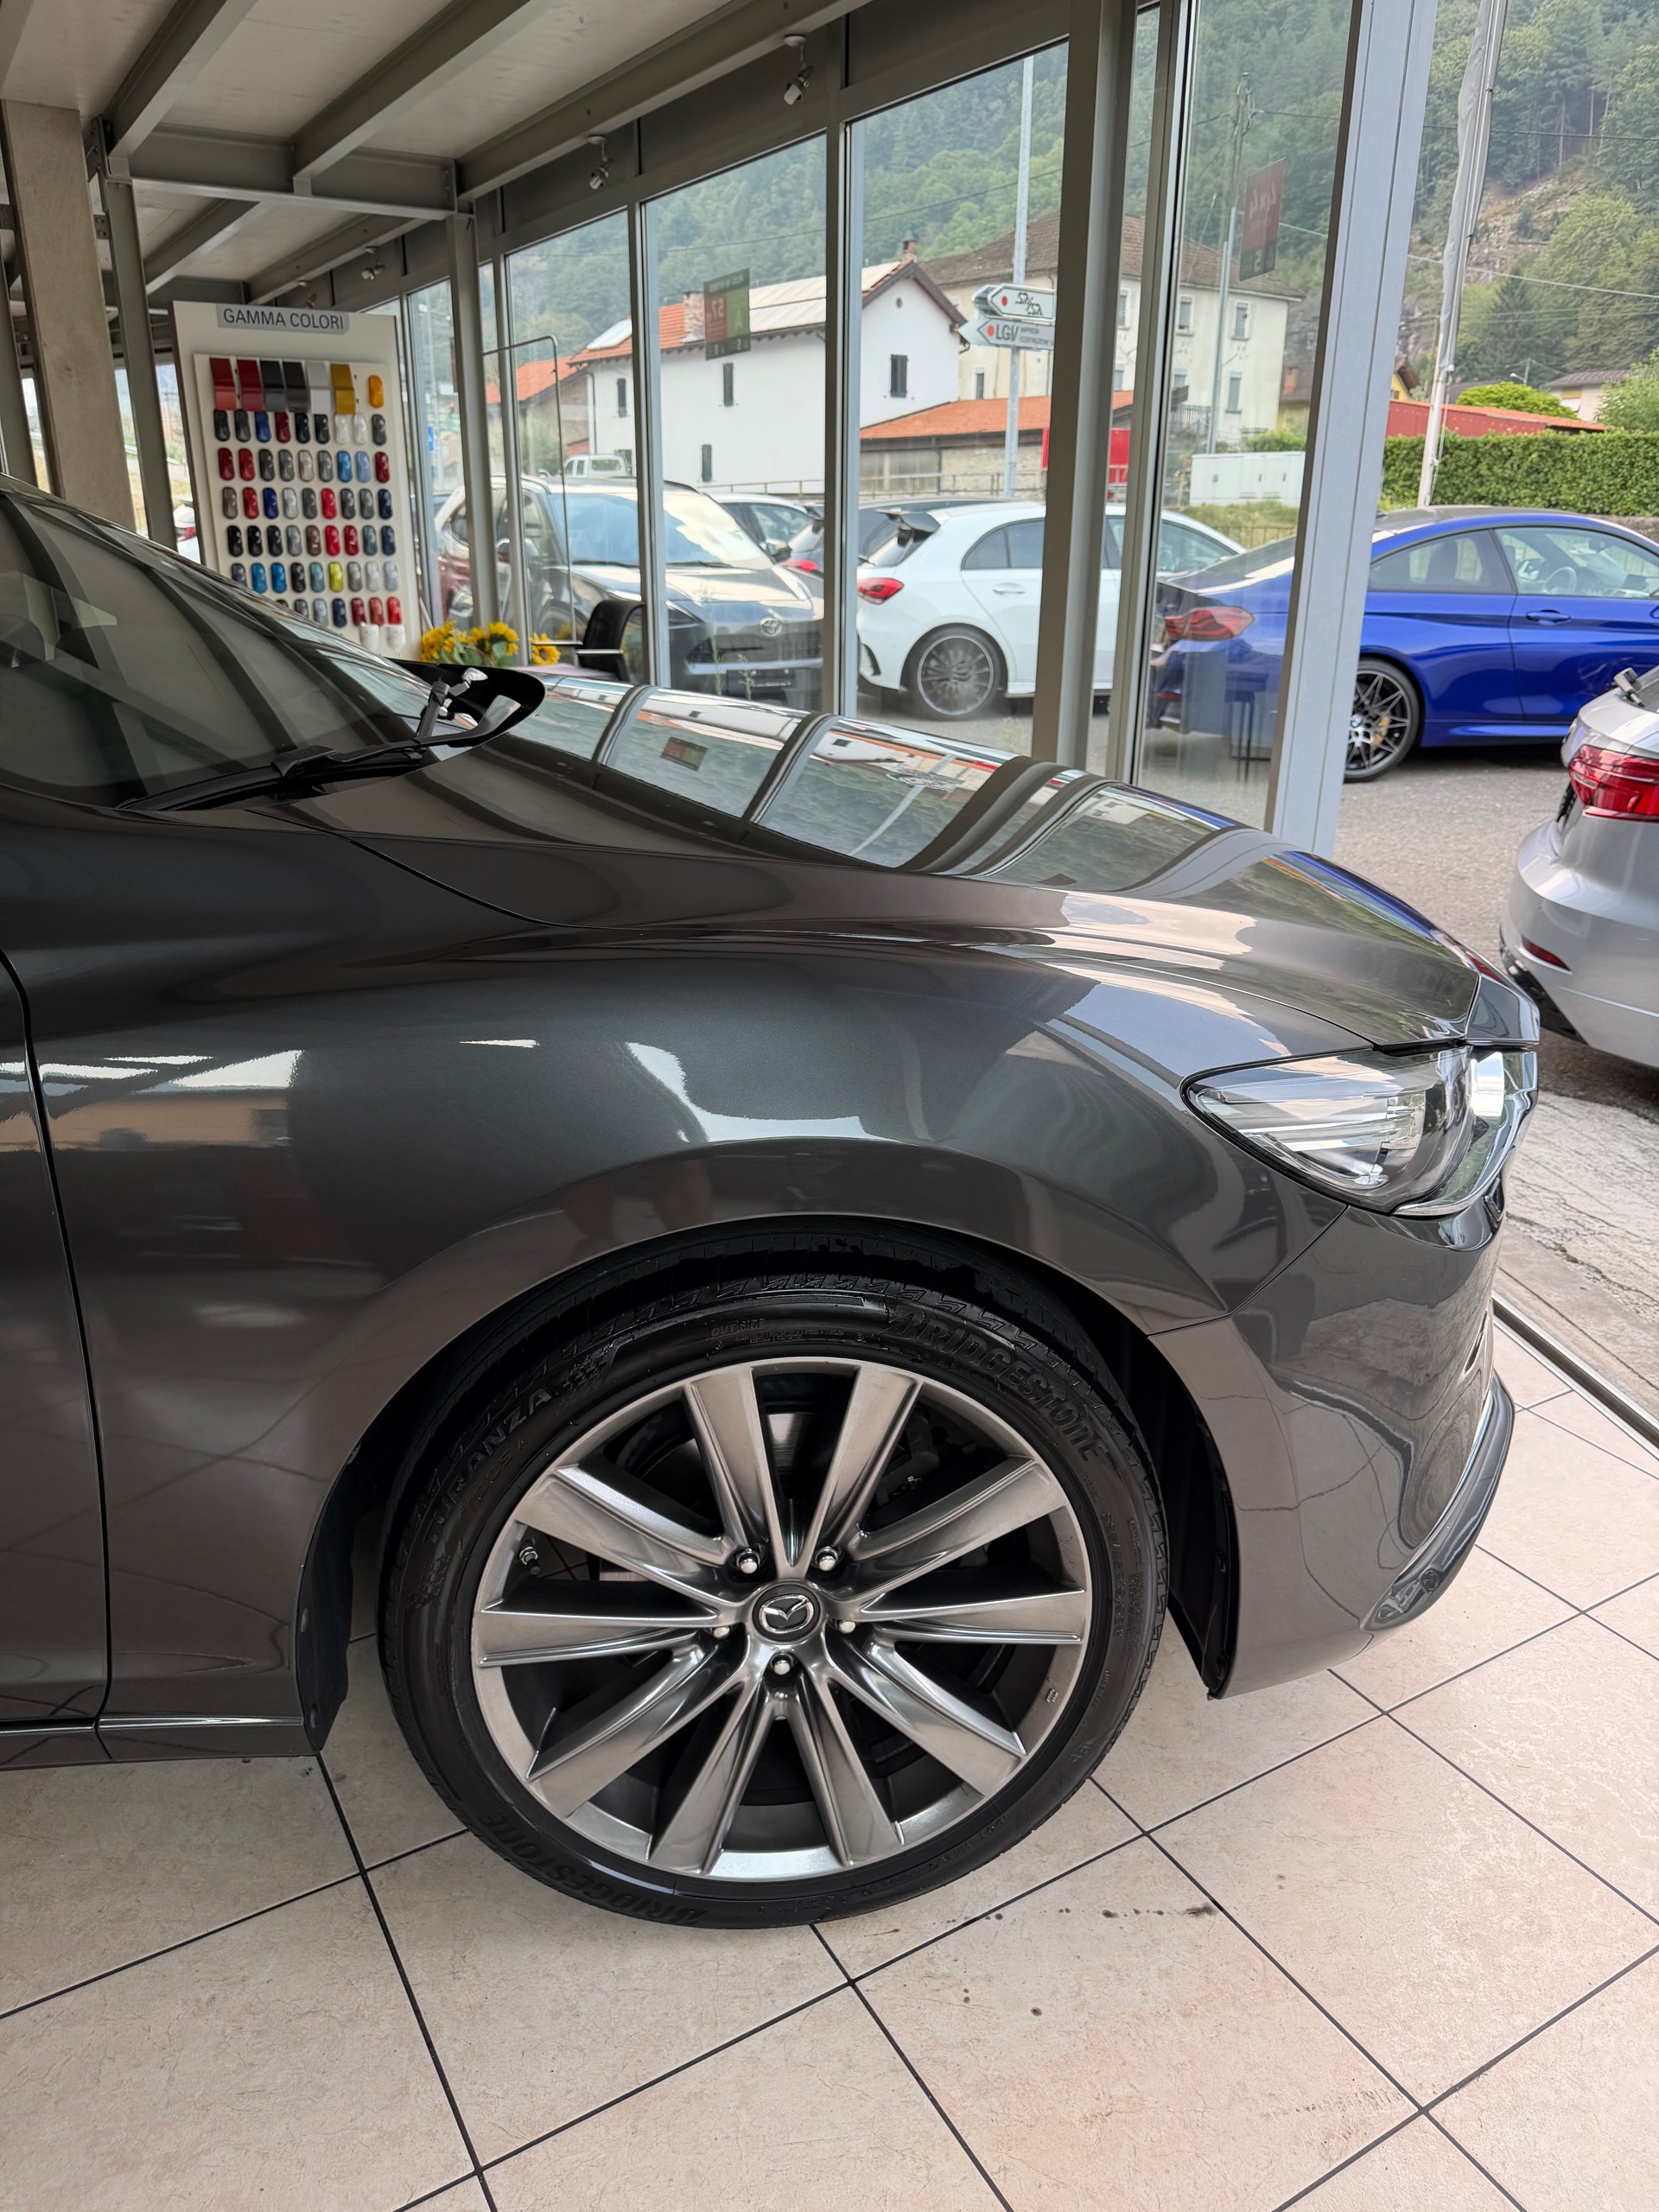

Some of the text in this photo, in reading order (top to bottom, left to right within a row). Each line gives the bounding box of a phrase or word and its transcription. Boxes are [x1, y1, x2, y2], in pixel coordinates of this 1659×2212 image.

[223, 308, 345, 330] GAMMA COLORI
[995, 324, 1020, 341] LGV
[711, 1318, 766, 1338] OUTSIDE
[877, 1305, 1109, 1462] BRIDGESTONE
[423, 1387, 554, 1544] TURANZA
[478, 1812, 709, 1925] BRIDGESTONE
